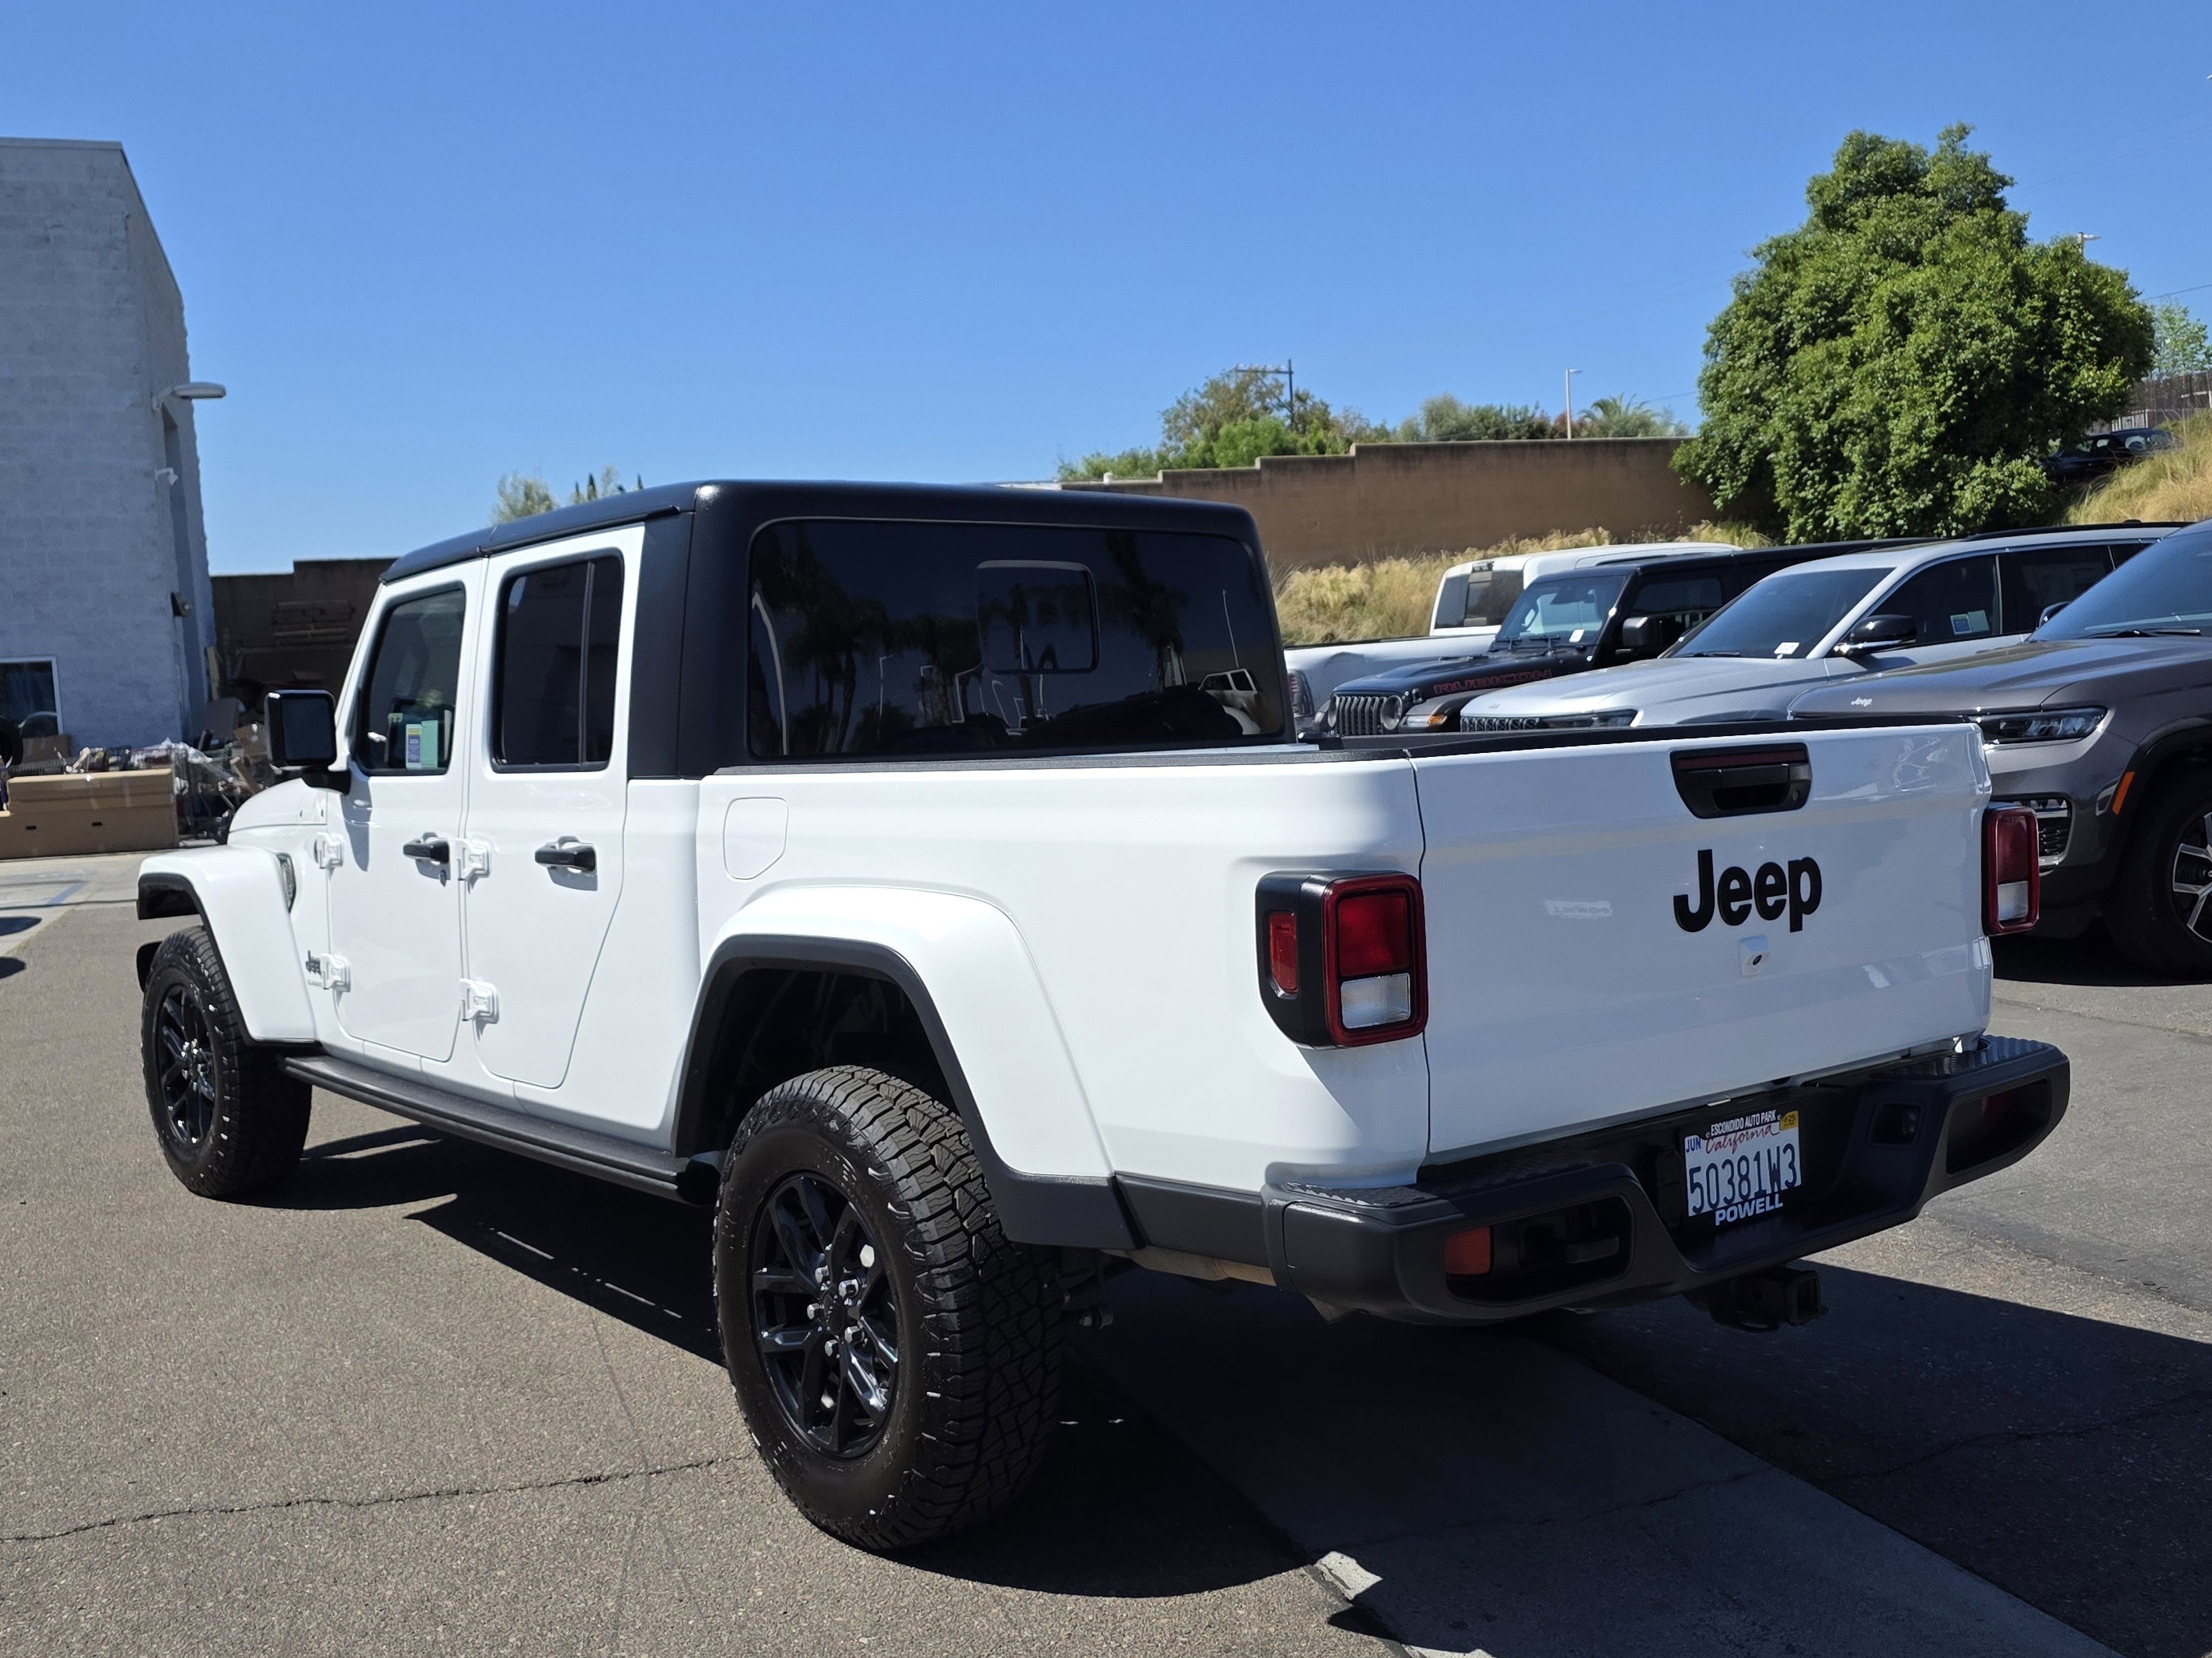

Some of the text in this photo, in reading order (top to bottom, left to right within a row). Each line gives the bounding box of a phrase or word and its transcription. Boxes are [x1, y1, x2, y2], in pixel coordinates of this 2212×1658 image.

[1434, 669, 1553, 695] RUBICON
[1673, 849, 1822, 933] Jeep
[1711, 1109, 1776, 1136] ESCONDIDO AUTO PARK
[1686, 1137, 1701, 1153] JUN
[1706, 1124, 1780, 1154] California
[1689, 1143, 1796, 1213] 50381W3
[1715, 1193, 1783, 1226] POWELL
